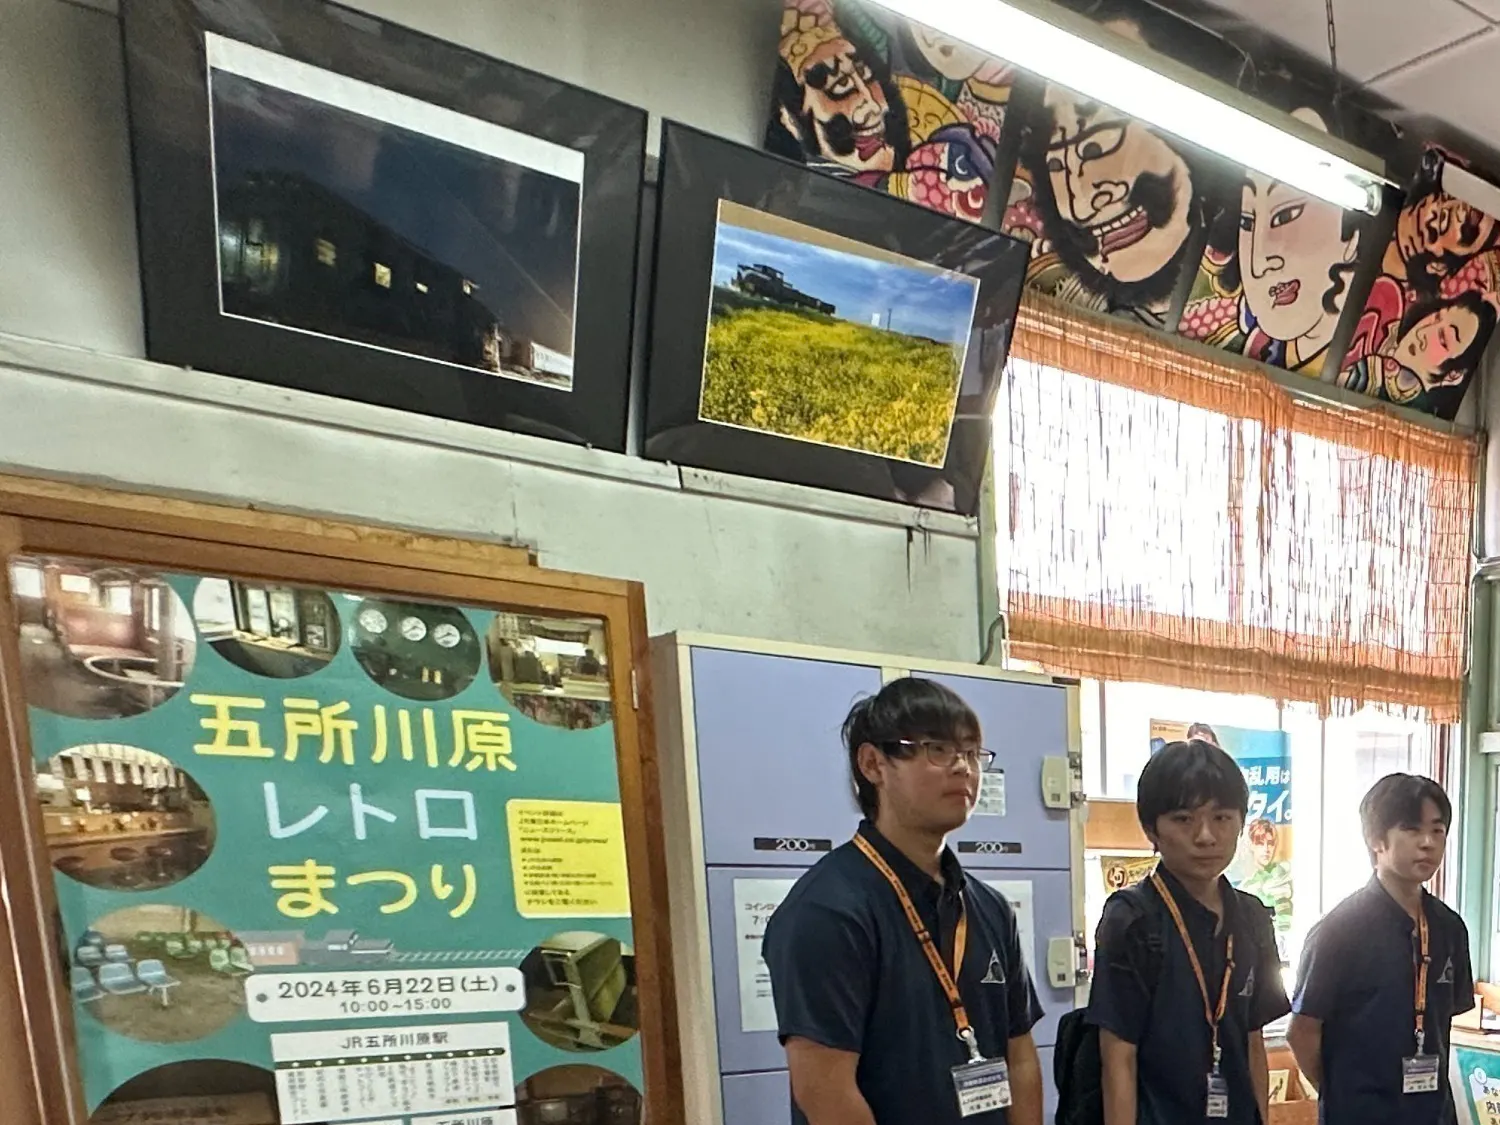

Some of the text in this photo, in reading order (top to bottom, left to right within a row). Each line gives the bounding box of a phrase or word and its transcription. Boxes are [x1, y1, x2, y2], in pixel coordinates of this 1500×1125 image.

[190, 694, 518, 771] 五所川原
[263, 781, 478, 840] レトロ
[268, 859, 477, 919] まつり
[278, 975, 499, 999] 2024年6月22日(土)
[341, 1032, 449, 1050] JR五所川原駅
